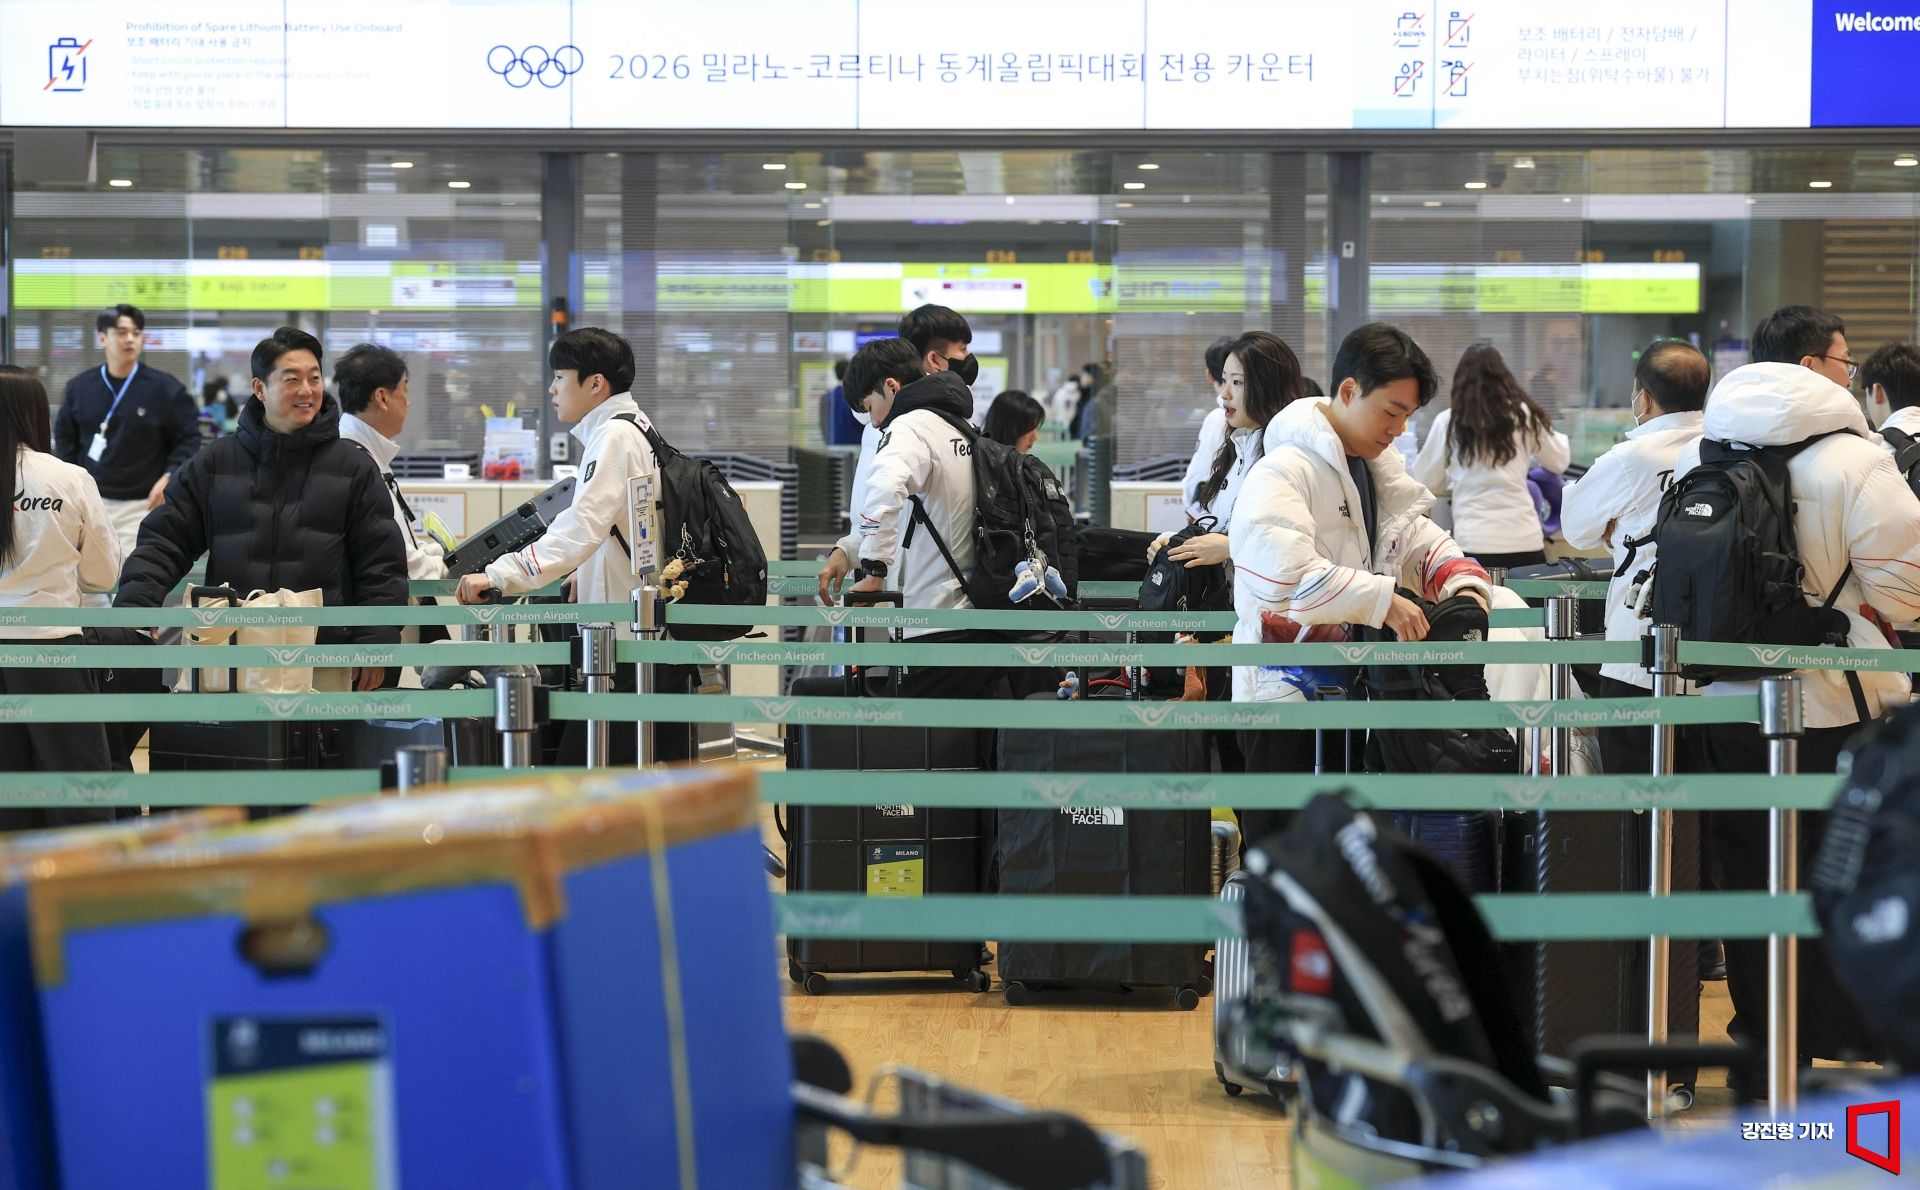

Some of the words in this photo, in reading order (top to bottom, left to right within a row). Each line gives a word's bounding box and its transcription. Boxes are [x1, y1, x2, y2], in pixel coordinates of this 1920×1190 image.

[126, 21, 188, 33] Prohibition
[190, 21, 203, 33] of
[205, 22, 237, 35] Spare
[239, 21, 282, 33] Lithium
[285, 22, 327, 36] Battery
[330, 23, 351, 33] Use
[353, 22, 403, 33] Onboard
[1835, 11, 1920, 32] Welcome
[1519, 26, 1548, 43] 보조
[1552, 26, 1600, 43] 배터리
[1606, 26, 1614, 43] /
[1620, 26, 1684, 43] 전자담배
[1689, 26, 1698, 43] /
[148, 36, 181, 49] 배터리
[1518, 47, 1565, 64] 라이터
[1571, 48, 1578, 64] /
[1584, 47, 1647, 64] 스프레이
[609, 54, 691, 83] 2026
[702, 53, 926, 83] 밀라노-코르티나
[936, 53, 1146, 84] 동계올림픽대회
[1159, 53, 1216, 84] 전용
[1227, 53, 1314, 84] 카운터
[1679, 66, 1711, 84] 불가
[225, 614, 264, 624] Incheon
[267, 614, 303, 626] Airport
[501, 611, 540, 621] Incheon
[543, 610, 579, 623] Airport
[851, 614, 890, 625] Incheon
[893, 615, 929, 627] Airport
[1128, 618, 1167, 629] Incheon
[1170, 618, 1206, 630] Airport
[36, 653, 78, 666] Airport
[304, 651, 349, 664] Incheon
[353, 651, 394, 665] Airport
[736, 650, 781, 662] Incheon
[785, 650, 825, 664] Airport
[1054, 652, 1099, 663] Incheon
[1103, 652, 1143, 666] Airport
[1373, 650, 1420, 661] Incheon
[1423, 650, 1464, 664] Airport
[1787, 653, 1833, 666] Incheon
[1836, 655, 1879, 669] Airport
[304, 702, 359, 715] Incheon
[363, 701, 413, 717] Airport
[796, 706, 851, 721] Incheon
[854, 706, 903, 723] Airport
[1553, 707, 1607, 723] Incheon
[1612, 706, 1661, 723] Airport
[1173, 711, 1227, 725] Incheon
[1231, 711, 1280, 727] Airport
[1060, 804, 1102, 815] NORTH
[1072, 814, 1102, 825] FACE
